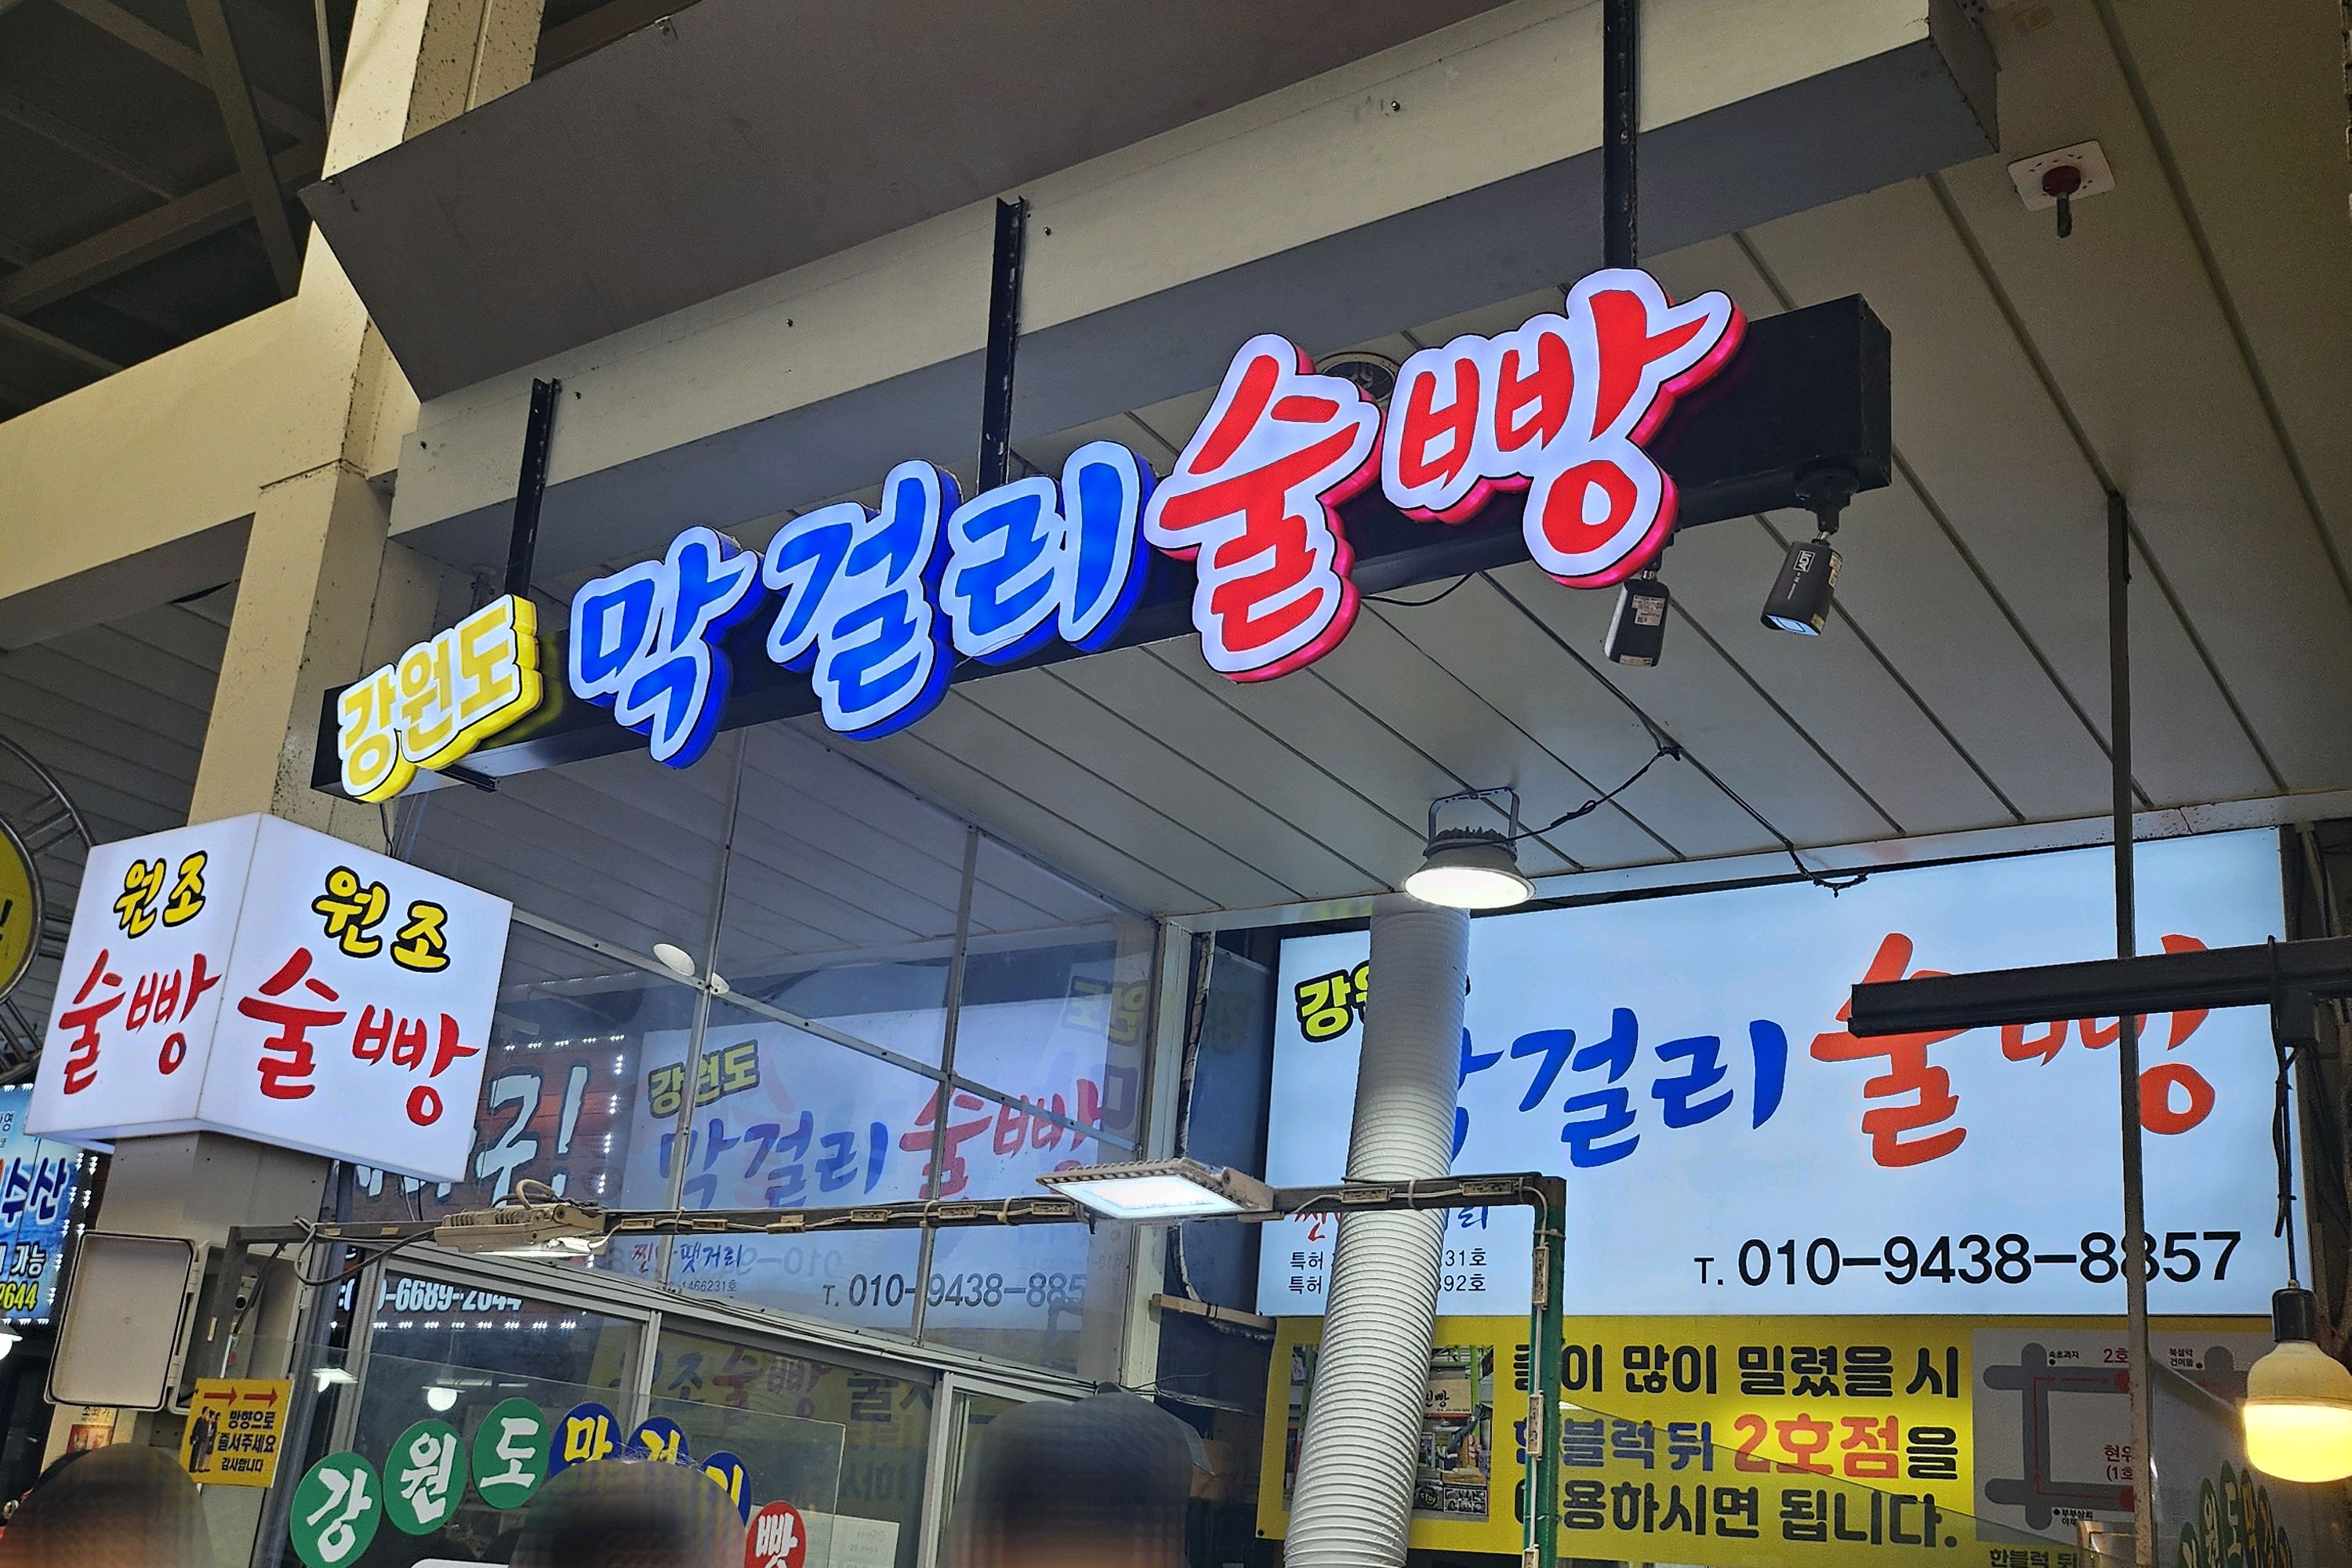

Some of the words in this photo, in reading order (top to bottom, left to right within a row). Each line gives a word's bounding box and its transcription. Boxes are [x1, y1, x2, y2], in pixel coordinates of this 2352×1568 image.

[338, 594, 538, 800] 강원도
[569, 441, 1151, 766] 막걸리
[1144, 268, 1744, 681] 술빵
[114, 850, 209, 938] 원조
[311, 866, 451, 973] 원조
[59, 949, 223, 1094] 술빵
[238, 947, 480, 1127] 술빵
[0, 1156, 69, 1226] 수산
[10, 1244, 46, 1278] 가능
[1288, 1275, 1323, 1294] 특허
[1290, 1251, 1324, 1270] 특허
[1694, 1258, 1724, 1286] T.
[1738, 1231, 2241, 1287] 010-9438-8857
[1623, 1344, 1719, 1395] 많이
[1738, 1345, 1894, 1398] 밀렸을
[1905, 1346, 1959, 1399] 시
[2103, 1347, 2129, 1364] 2호
[228, 1410, 277, 1430] 방향으로
[1513, 1417, 1655, 1471] 블럭
[1667, 1421, 1715, 1472] 뒤
[1733, 1413, 1959, 1480] 2호점을
[307, 1416, 541, 1563] 강원도
[1779, 1489, 1958, 1548] 됩니다.
